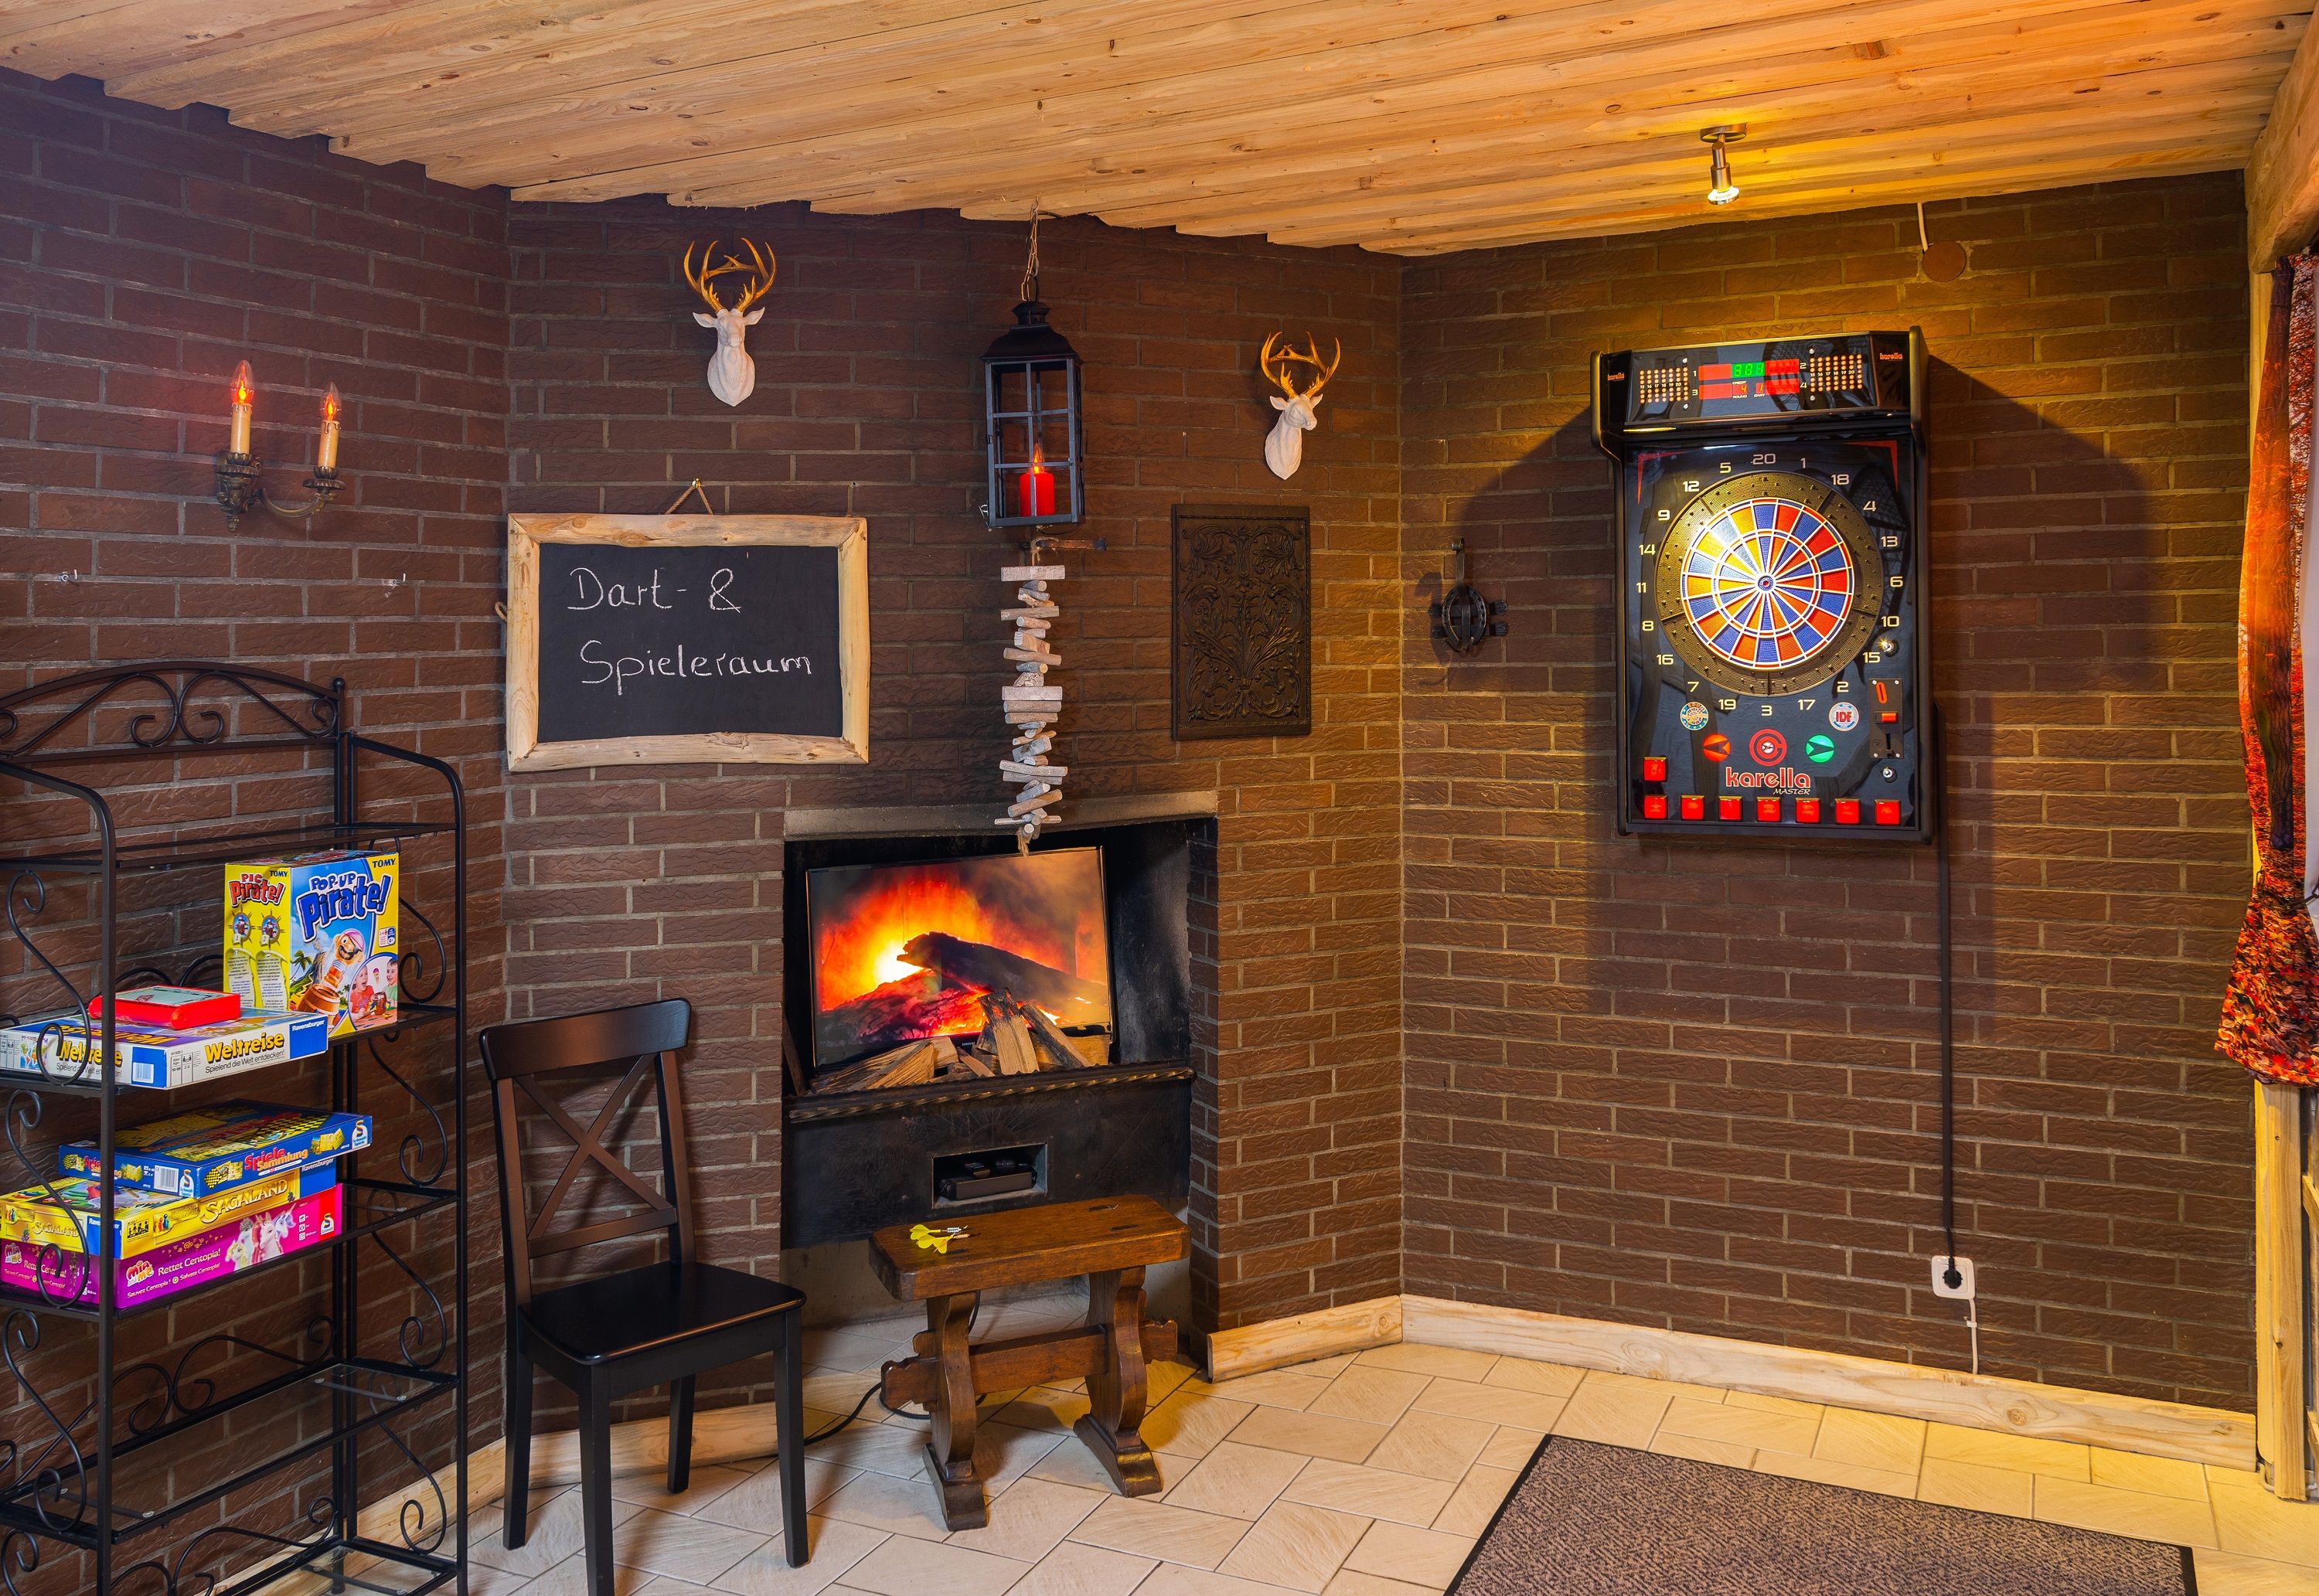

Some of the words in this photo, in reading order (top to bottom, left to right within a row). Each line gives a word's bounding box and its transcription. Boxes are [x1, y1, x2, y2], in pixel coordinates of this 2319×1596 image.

[1800, 362, 1807, 370] 2
[1752, 453, 1776, 465] 20
[1800, 458, 1807, 468] 1
[1719, 462, 1732, 474] 5
[1830, 474, 1850, 485] 18
[1683, 481, 1700, 492] 12
[1863, 500, 1877, 512] 4
[1657, 509, 1670, 521] 9
[1881, 536, 1898, 547] 13
[1639, 543, 1656, 556] 14
[1890, 576, 1903, 587] 6
[567, 567, 687, 611] Dart-
[708, 568, 742, 614] &
[1636, 582, 1647, 594] 11
[1642, 620, 1654, 631] 8
[1881, 615, 1900, 628] 10
[1656, 654, 1674, 665] 16
[1862, 652, 1881, 663] 15
[580, 639, 812, 696] Spieleraum
[1687, 681, 1700, 693] 7
[1837, 681, 1850, 693] 2
[1718, 699, 1737, 710] 19
[1761, 705, 1773, 716] 3
[1797, 699, 1816, 710] 17
[1835, 711, 1853, 723] IDF
[1725, 766, 1811, 788] karella
[372, 858, 397, 868] TOMY
[241, 873, 263, 883] PIC
[311, 873, 357, 891] POP-UP
[229, 879, 285, 907] Pirate!
[298, 874, 392, 941] Pirate!
[291, 1019, 325, 1032] Ravensburger
[204, 1033, 285, 1064] Weltreise
[205, 1061, 232, 1074] Spielend
[241, 1057, 254, 1065] Welt
[254, 1050, 285, 1063] entdecken!
[257, 1149, 309, 1172] Sammlung
[200, 1178, 289, 1224] SAGALAND
[158, 1262, 183, 1276] Rettet
[184, 1247, 221, 1268] Centopia!
